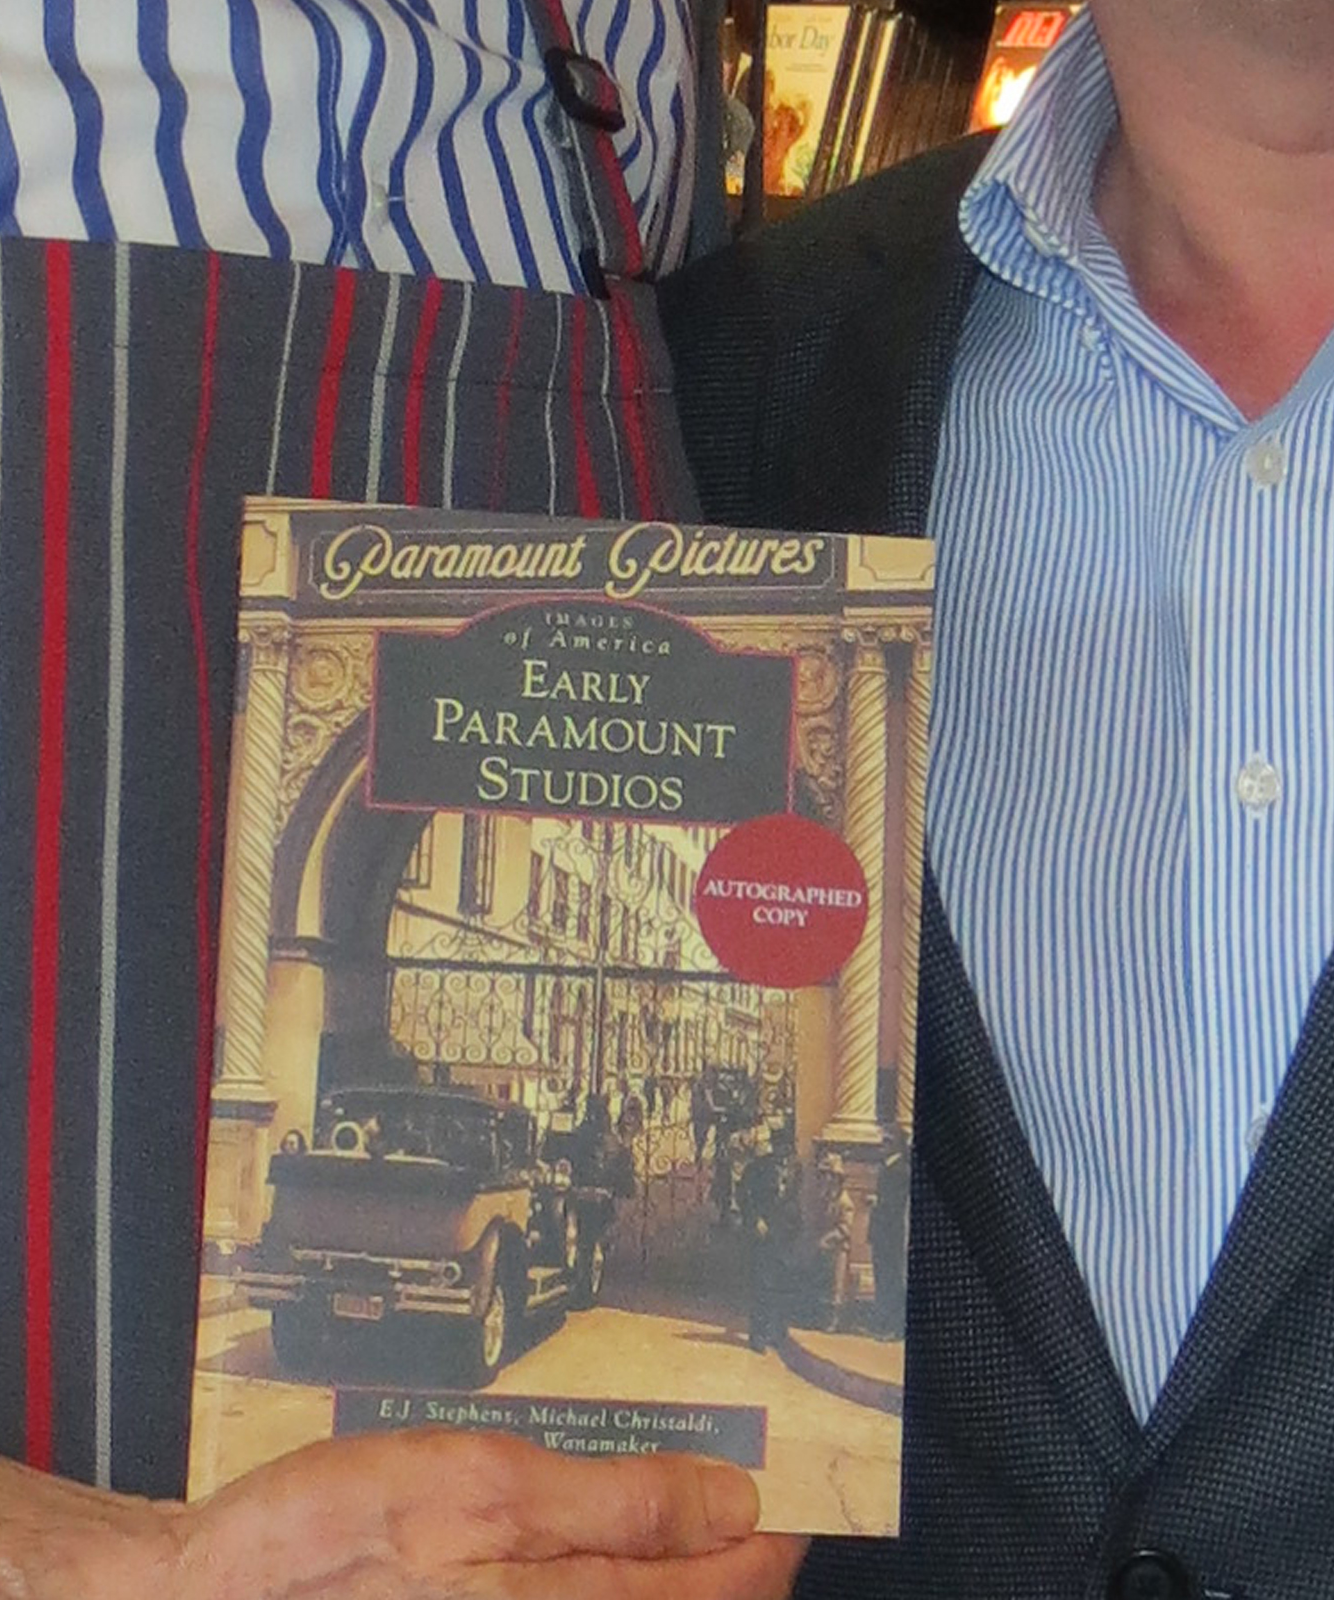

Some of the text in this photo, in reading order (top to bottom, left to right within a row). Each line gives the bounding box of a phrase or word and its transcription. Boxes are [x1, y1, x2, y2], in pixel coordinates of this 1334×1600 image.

[799, 25, 836, 58] Day
[319, 521, 826, 601] Paramount Pictures
[544, 612, 635, 629] IMAGES
[503, 626, 671, 656] of America
[521, 659, 651, 705] EARLY
[432, 697, 737, 759] PARAMOUNT
[476, 756, 684, 811] STUDIOS
[702, 879, 863, 908] AUTOGRAPHED
[752, 905, 809, 927] COPY
[425, 1401, 519, 1426] Stephens,
[528, 1404, 607, 1428] Michael
[543, 1430, 661, 1454] Wanamaker
